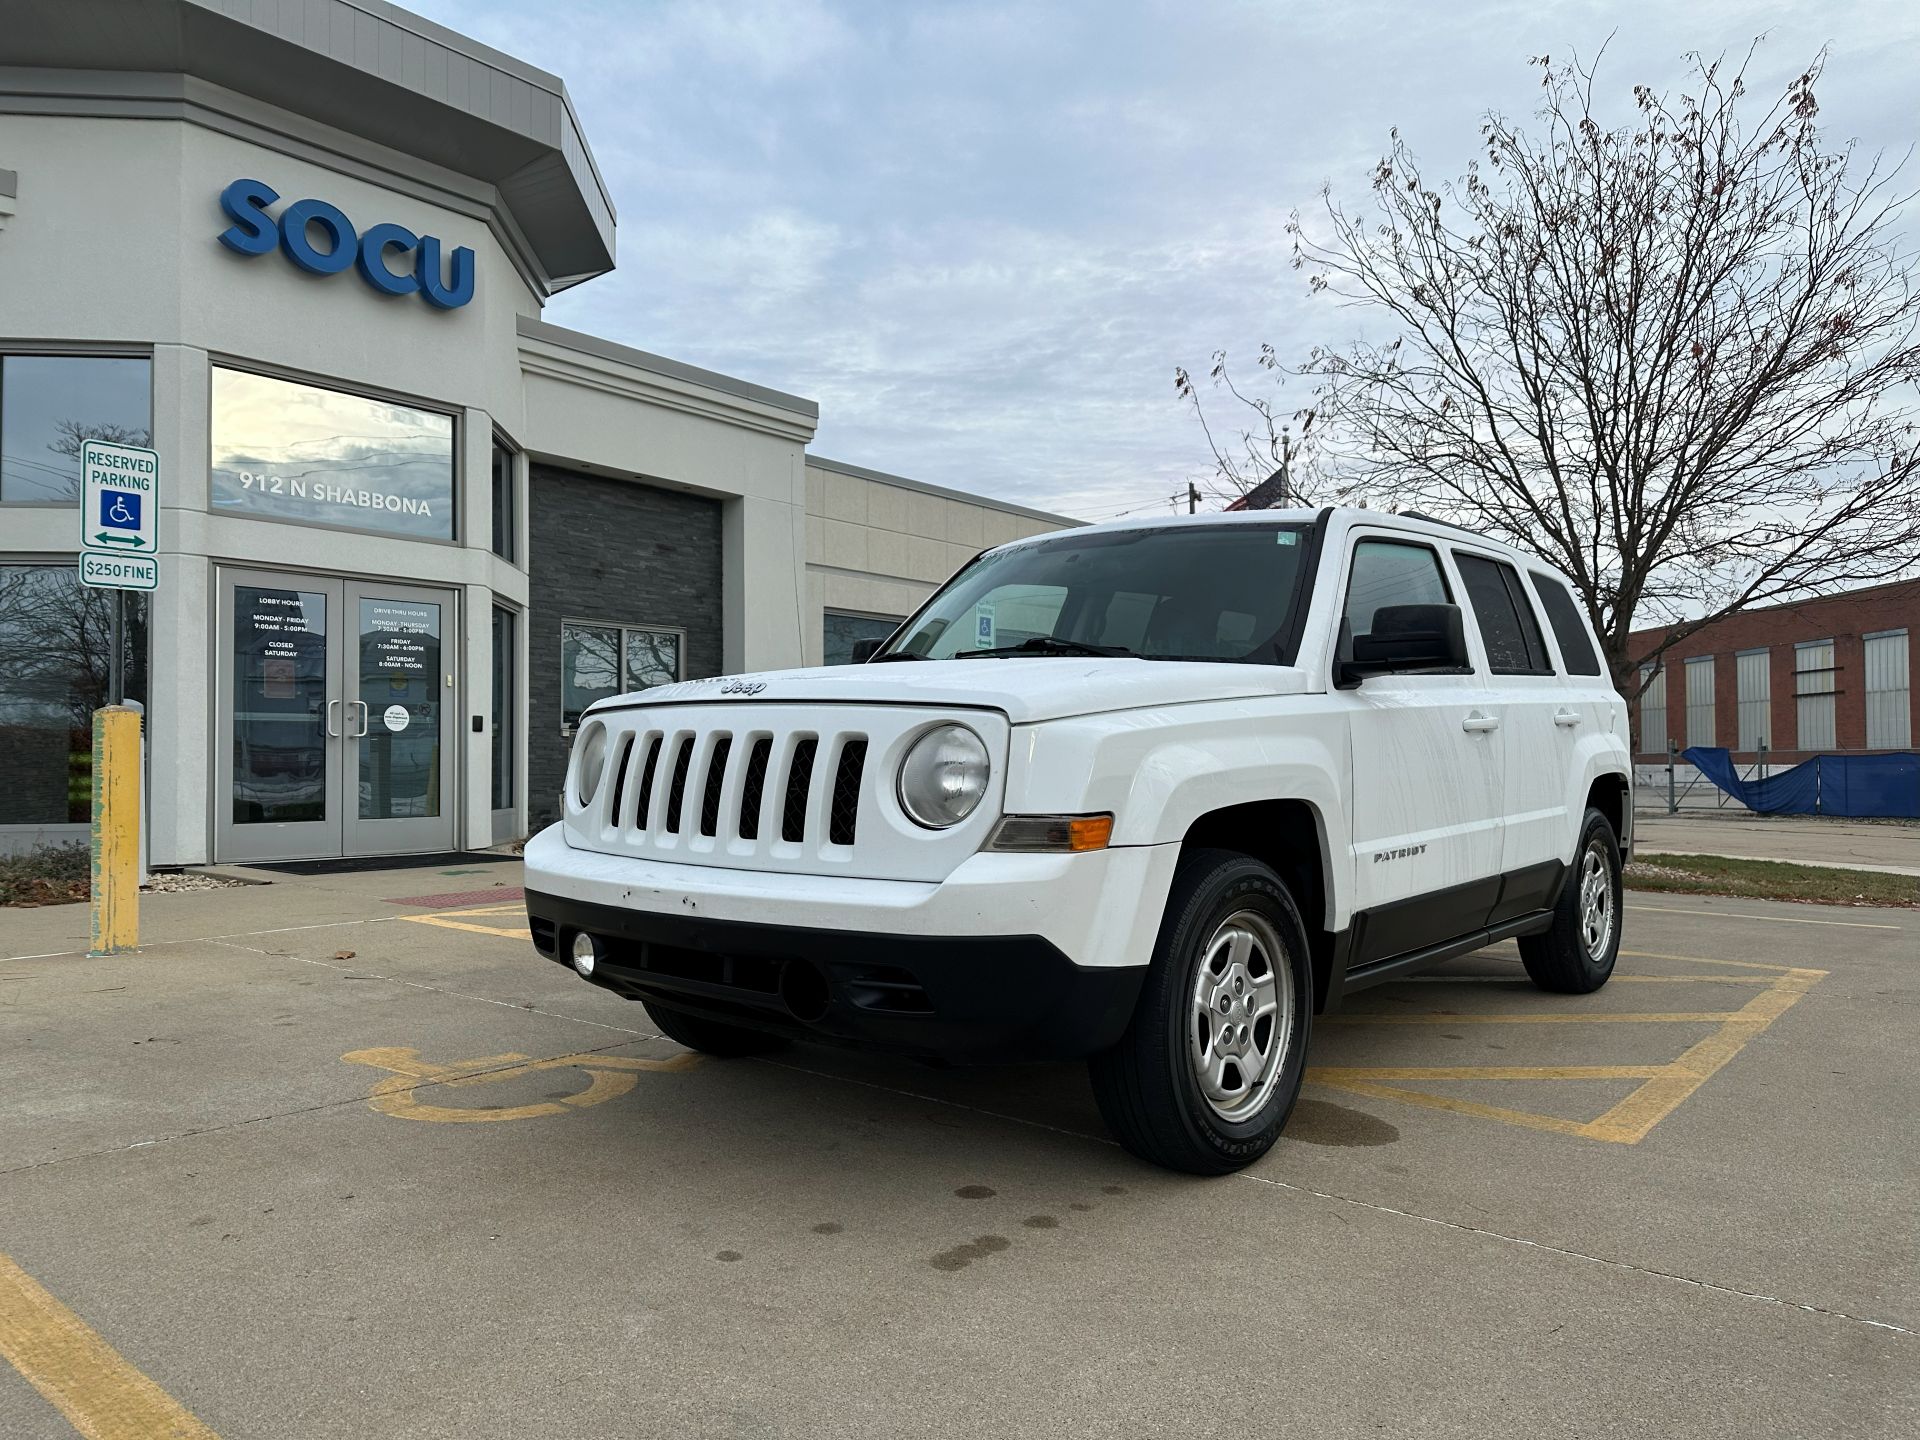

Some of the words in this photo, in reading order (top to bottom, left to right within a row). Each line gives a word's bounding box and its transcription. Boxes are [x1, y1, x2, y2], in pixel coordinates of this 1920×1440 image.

[217, 179, 475, 309] SOCU
[87, 451, 154, 474] RESERVED
[91, 470, 150, 491] PARKING
[239, 471, 283, 495] 912
[290, 479, 306, 498] N
[312, 483, 432, 517] SHABBONA
[86, 560, 121, 577] $250
[123, 565, 154, 580] FINE
[259, 597, 280, 605] LOBBY
[253, 614, 283, 622] MONDAY
[286, 616, 309, 624] FRIDAY
[254, 622, 280, 631] 9:00AM
[371, 619, 397, 627] MONDAY
[400, 621, 430, 629] THURSDAY
[264, 649, 298, 657] SATURDAY
[268, 641, 294, 649] CLOSED
[720, 680, 768, 697] Jeep
[1373, 843, 1428, 864] PATRIOT
